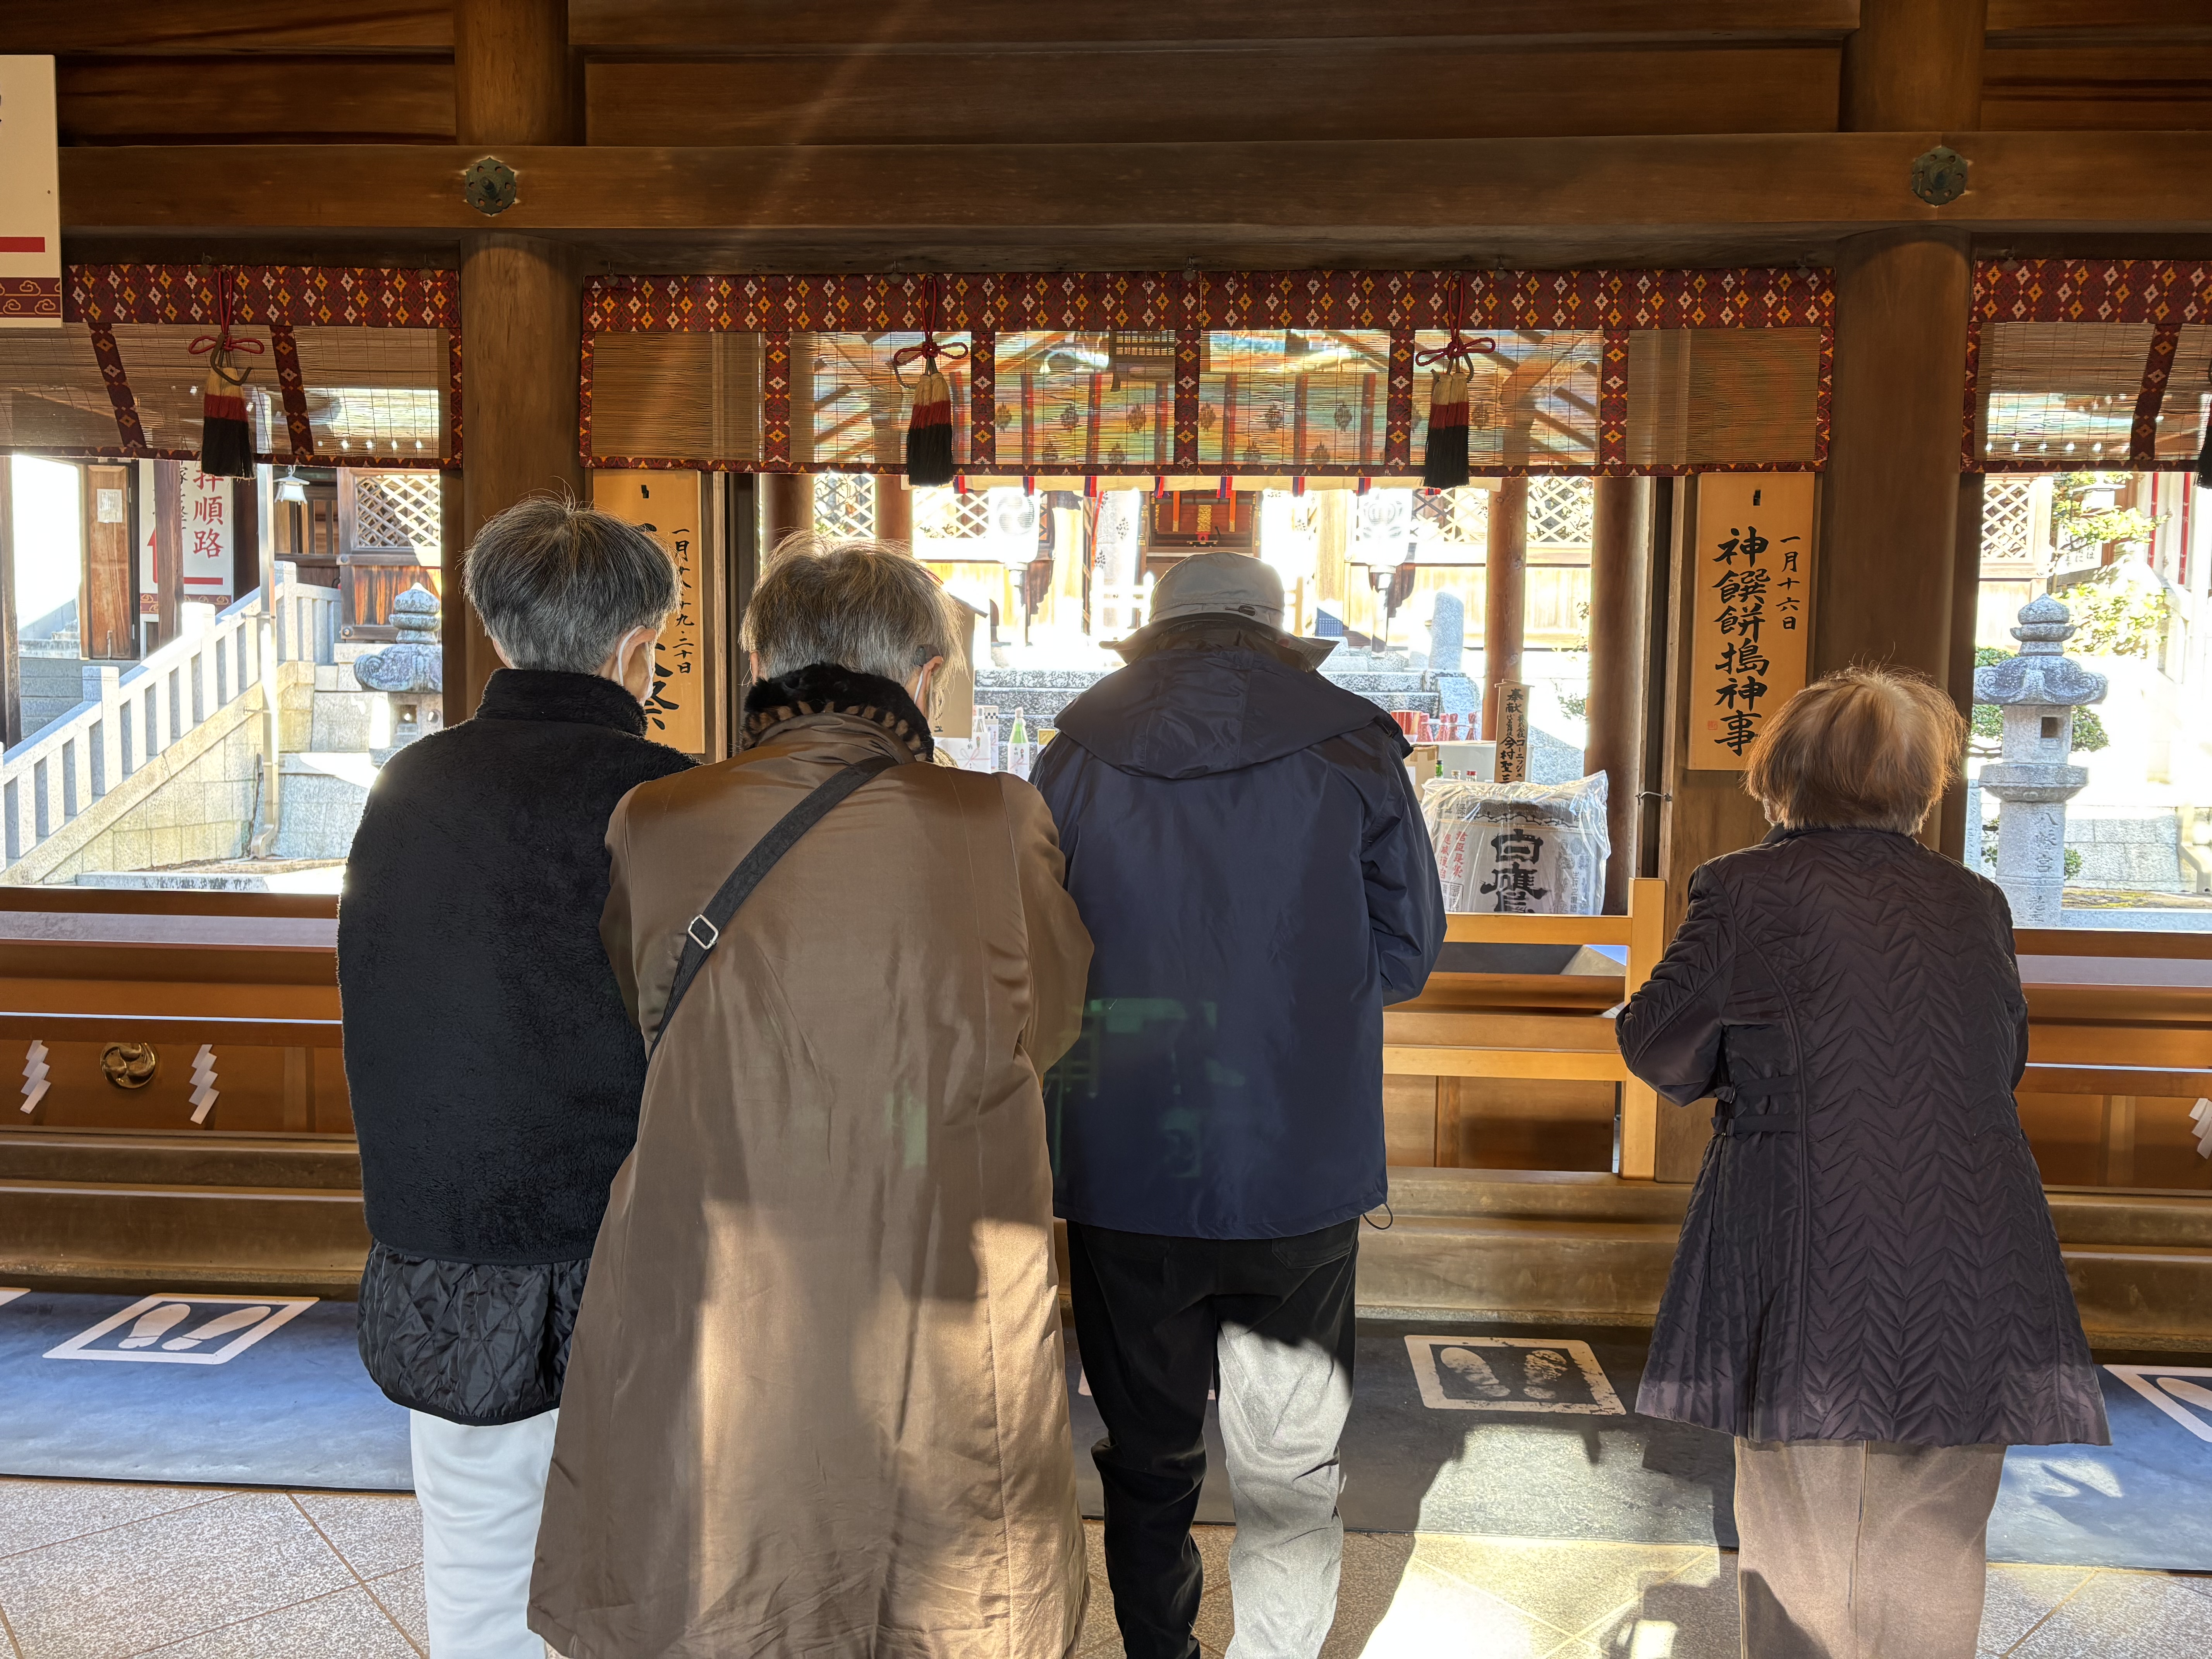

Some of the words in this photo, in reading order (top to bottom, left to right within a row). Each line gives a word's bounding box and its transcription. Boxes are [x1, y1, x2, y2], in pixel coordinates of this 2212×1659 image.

[1776, 536, 1801, 630] 一月十六日
[1506, 688, 1524, 713] 奉献
